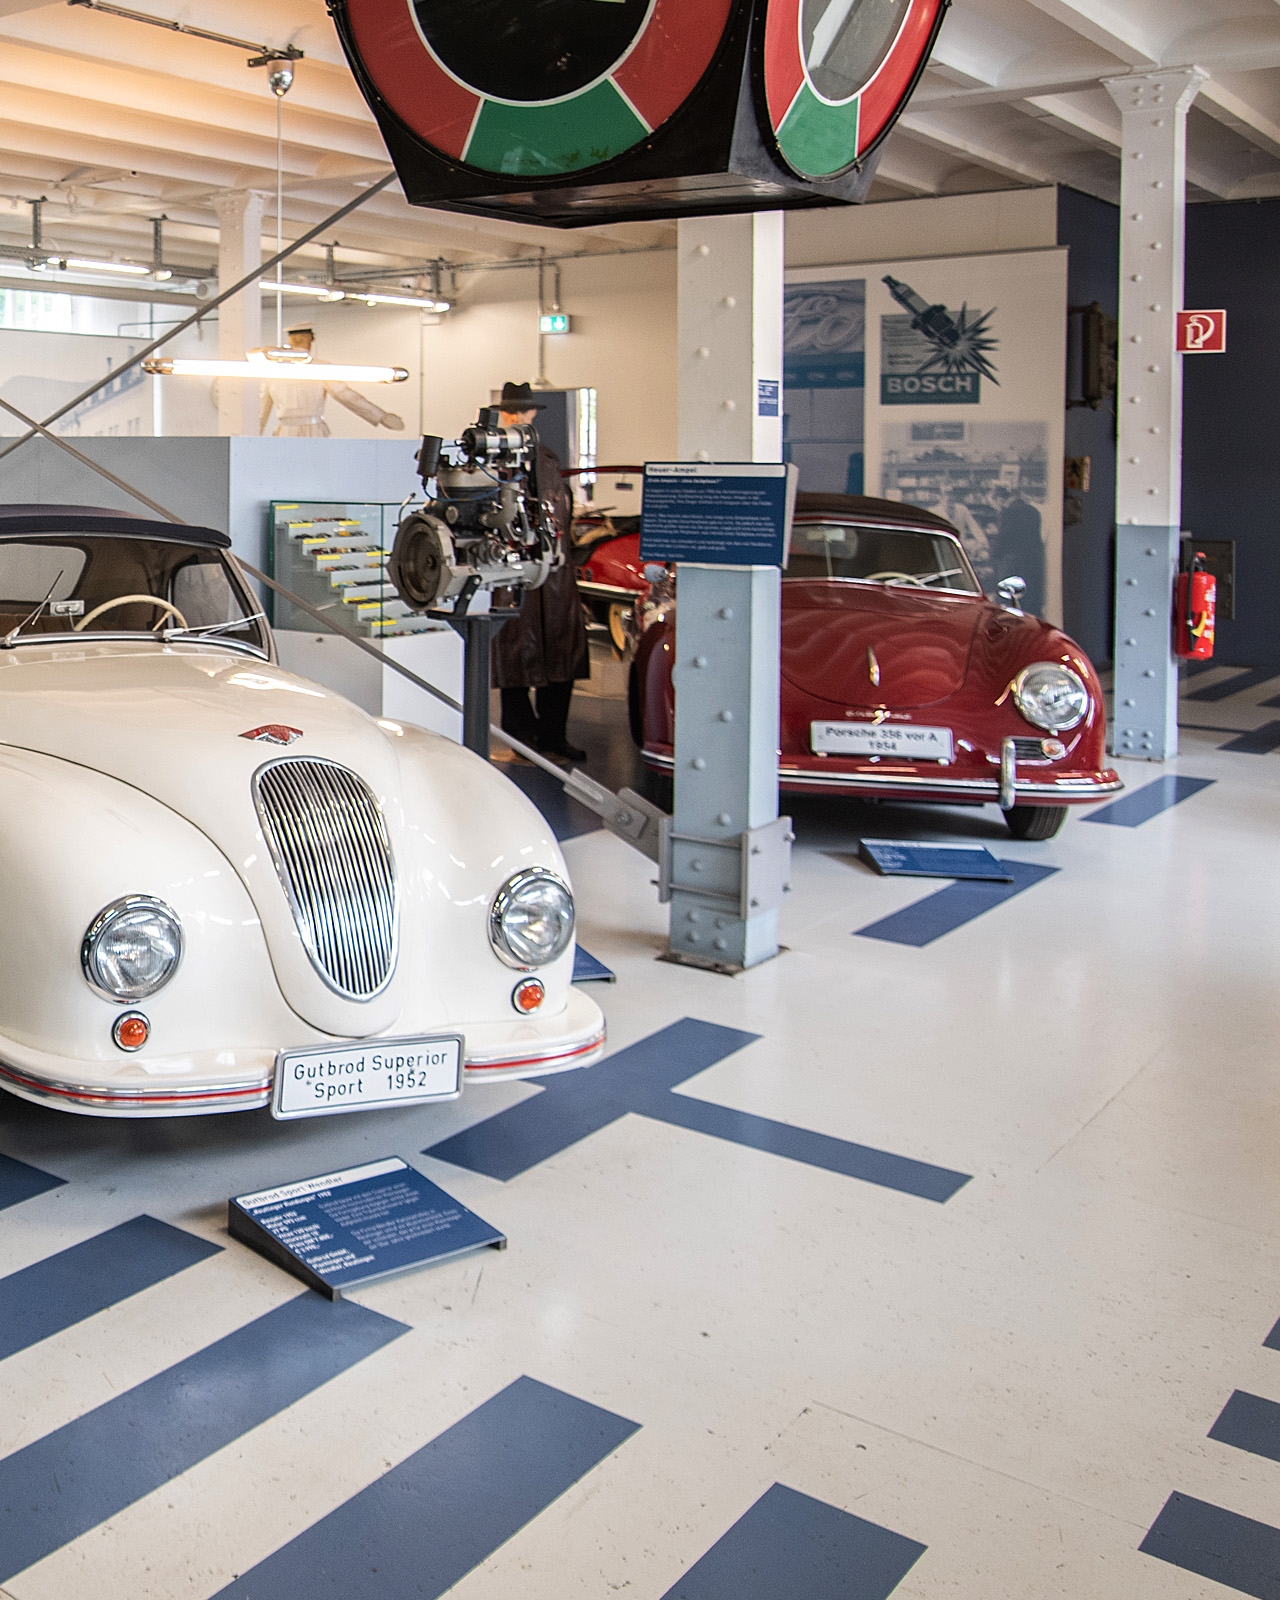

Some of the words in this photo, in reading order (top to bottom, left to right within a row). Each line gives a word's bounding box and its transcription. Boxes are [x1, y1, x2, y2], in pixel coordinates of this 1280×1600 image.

[886, 376, 973, 394] BOSCH
[825, 726, 877, 739] Porsche
[927, 732, 938, 743] A
[294, 1057, 364, 1080] Gutbrod
[372, 1050, 448, 1072] Superior
[314, 1079, 363, 1101] Sport
[387, 1071, 427, 1090] 1952
[242, 1192, 280, 1207] Gutbrod
[280, 1186, 306, 1197] Sport
